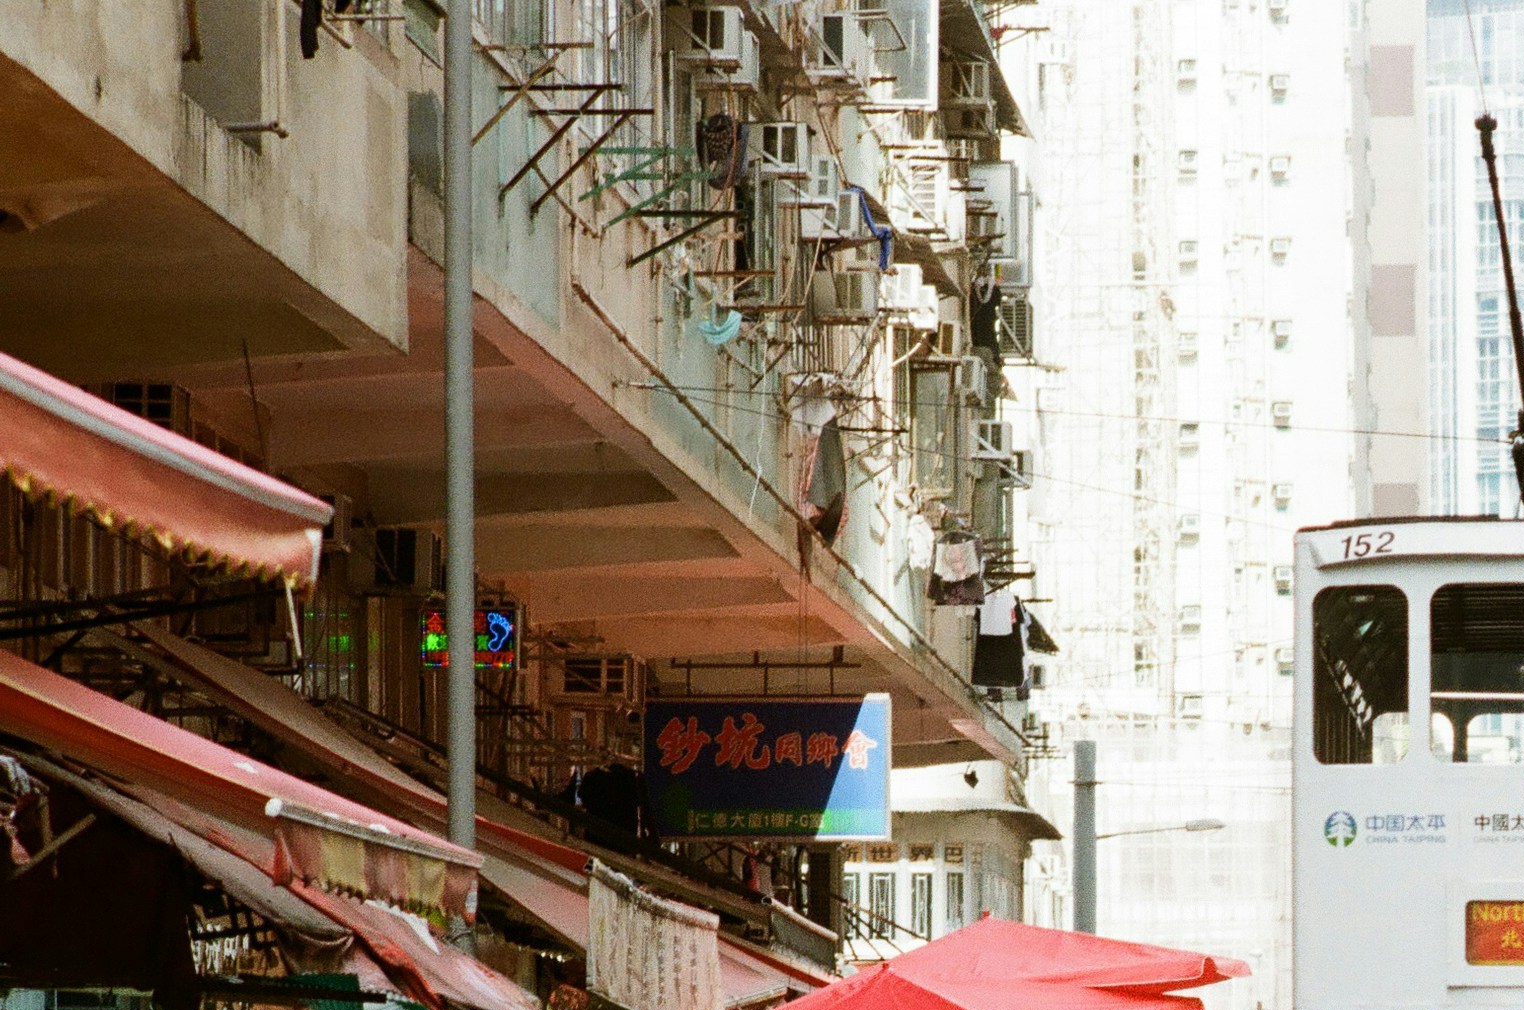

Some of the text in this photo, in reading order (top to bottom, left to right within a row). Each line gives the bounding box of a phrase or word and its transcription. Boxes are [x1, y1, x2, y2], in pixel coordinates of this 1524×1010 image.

[1341, 531, 1395, 559] 152
[1366, 814, 1446, 832] 中国太平
[1366, 834, 1447, 845] CHINA TAIPING
